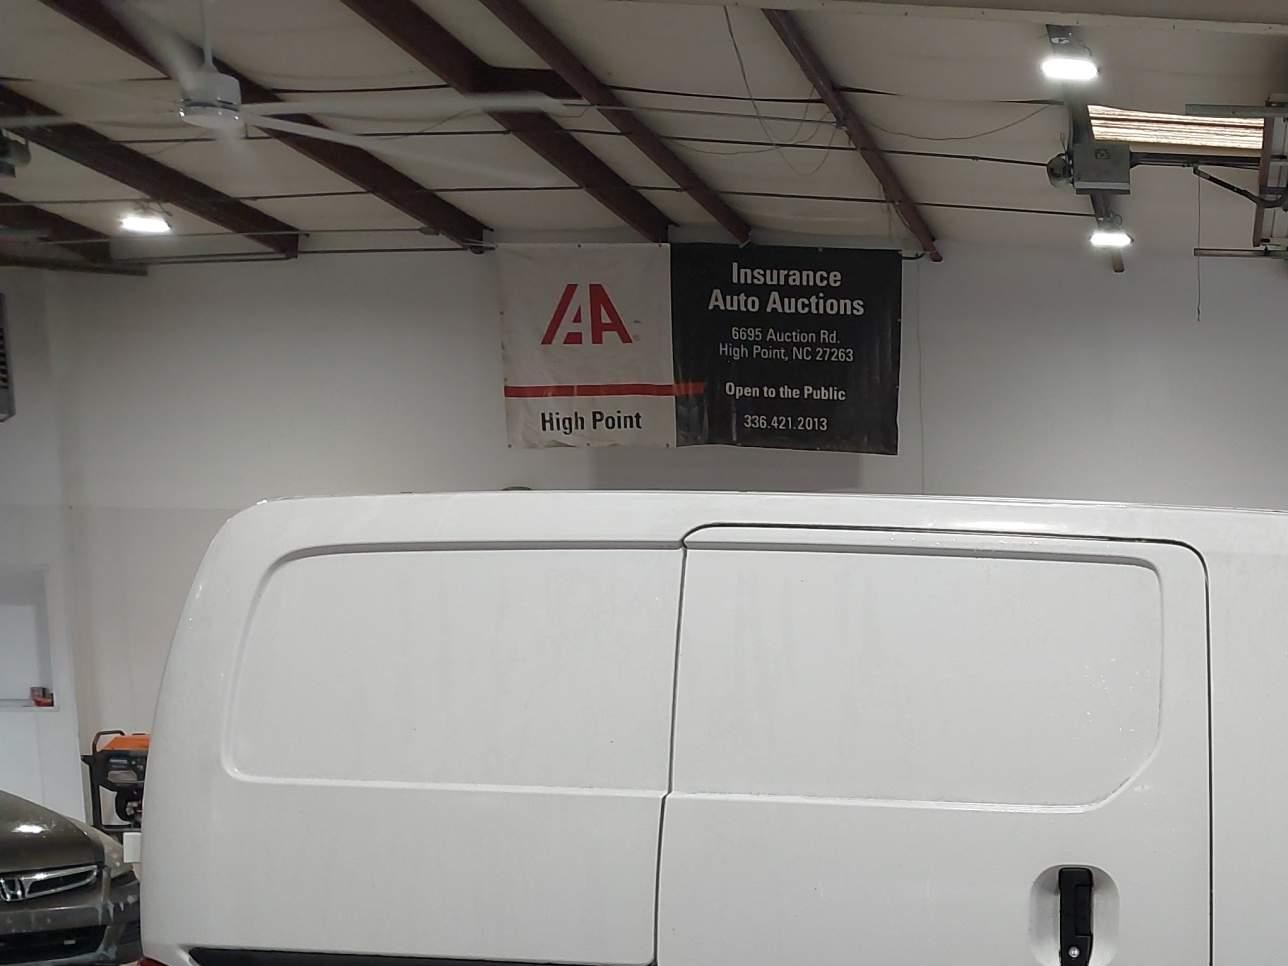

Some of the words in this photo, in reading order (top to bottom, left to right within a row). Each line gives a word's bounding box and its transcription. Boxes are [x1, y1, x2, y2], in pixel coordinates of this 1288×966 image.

[732, 262, 842, 287] Insurance
[708, 289, 760, 312] Auto
[766, 291, 865, 316] Auctions
[731, 327, 762, 341] 6695
[766, 328, 816, 343] Auction
[820, 330, 840, 344] Rd.
[719, 343, 749, 360] High
[753, 345, 789, 362] Point,
[794, 347, 812, 361] NC
[815, 348, 854, 362] 27263
[725, 382, 760, 400] Open
[763, 386, 776, 398] to
[780, 385, 800, 399] the
[804, 385, 846, 400] Public
[541, 412, 585, 434] High
[592, 411, 642, 430] Point
[743, 414, 828, 431] 336.421.2013
